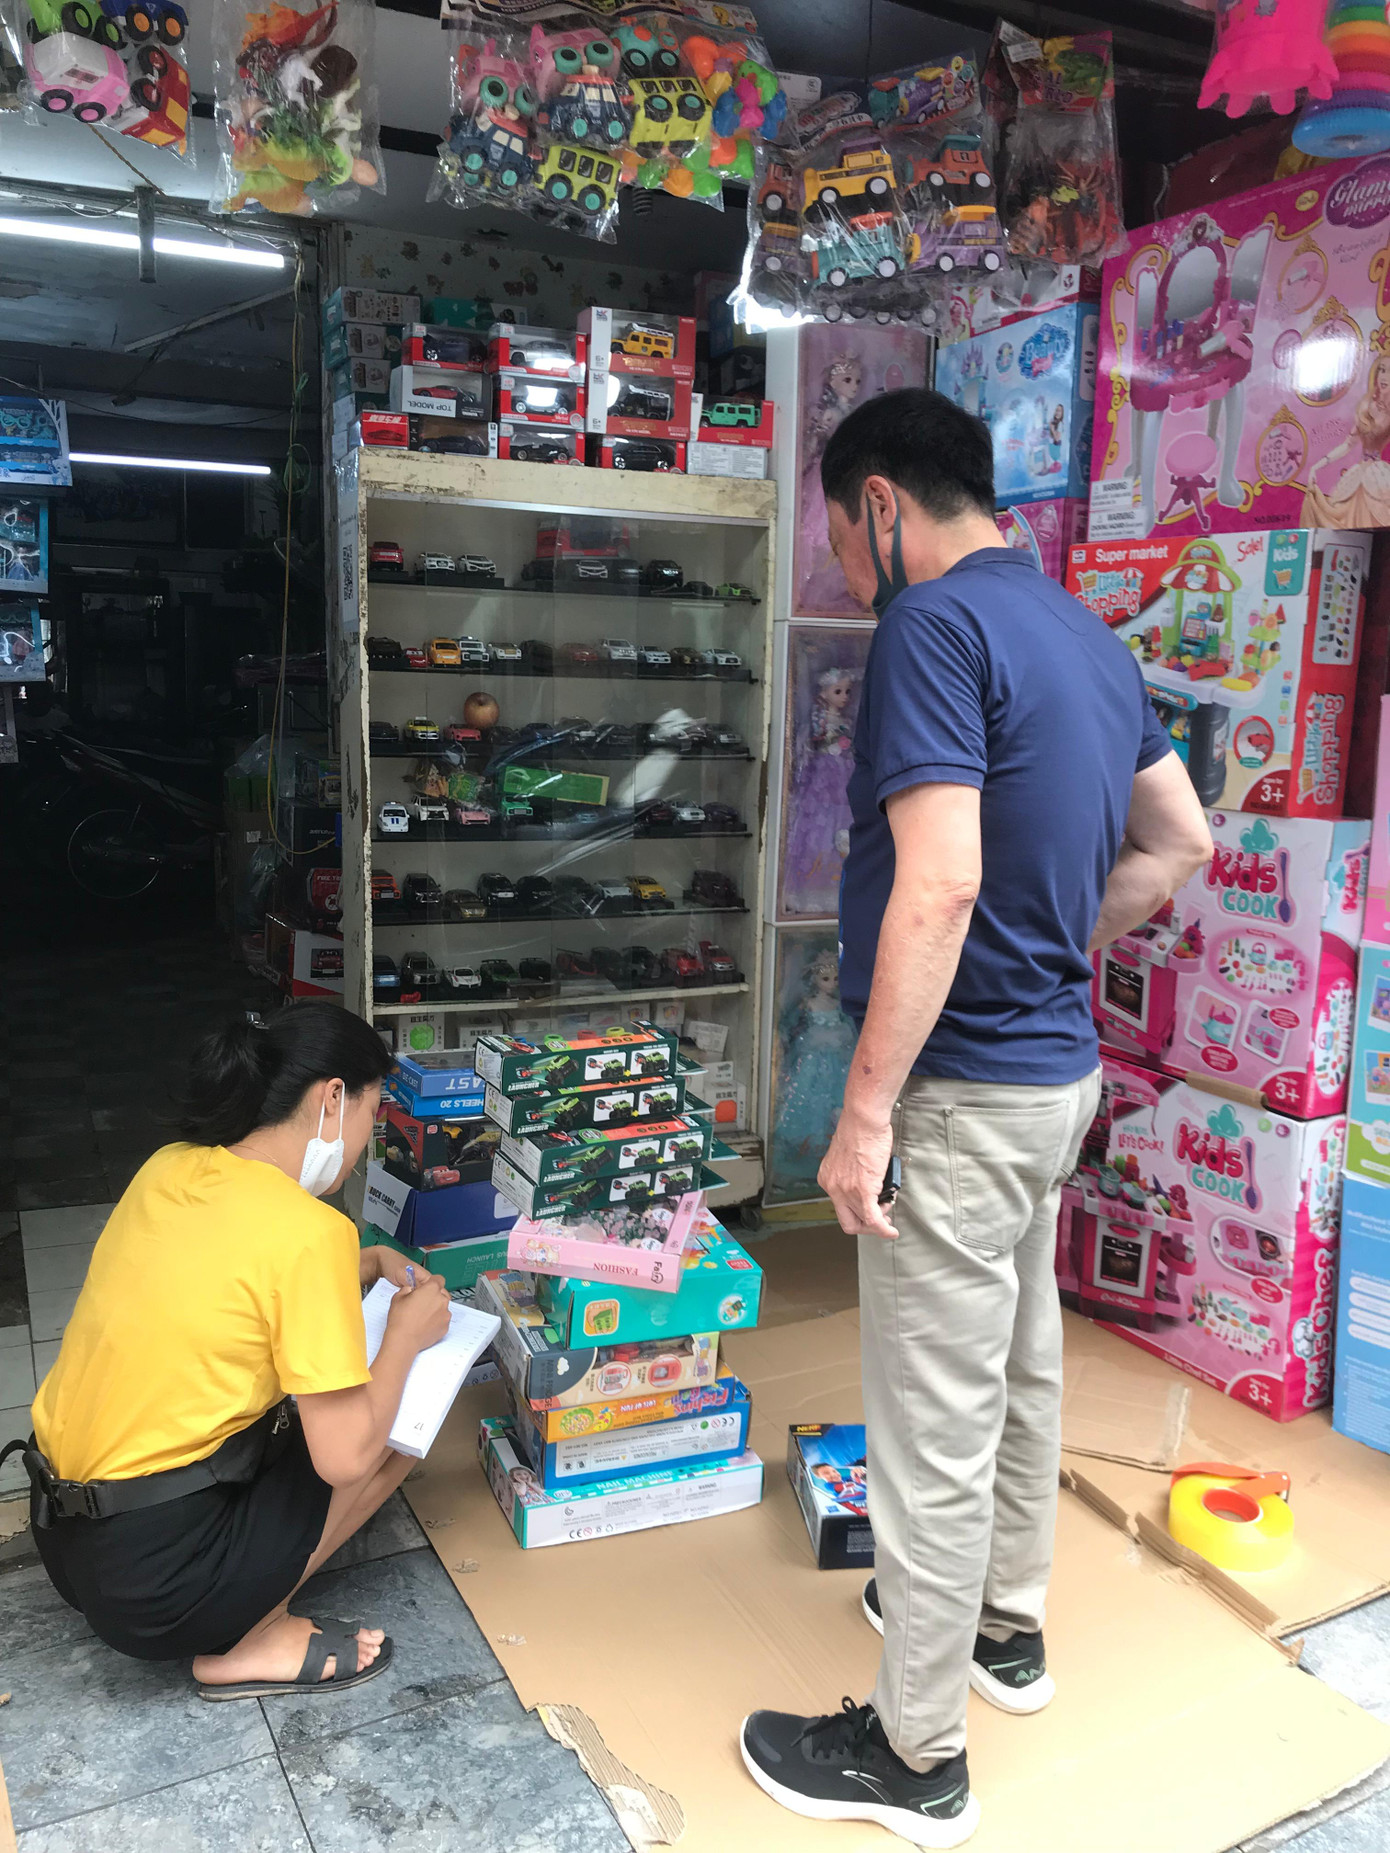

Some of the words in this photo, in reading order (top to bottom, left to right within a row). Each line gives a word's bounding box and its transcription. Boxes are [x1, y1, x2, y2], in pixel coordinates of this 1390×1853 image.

[1330, 178, 1390, 208] Glam
[407, 400, 434, 411] MODEL
[436, 404, 452, 412] TOP
[1095, 548, 1127, 564] Super
[1129, 545, 1168, 560] market
[1273, 548, 1299, 562] Kids
[1313, 696, 1343, 803] Shopping
[1260, 784, 1284, 803] 3+
[1207, 848, 1278, 894] Kids
[1342, 859, 1361, 912] Kids
[1222, 890, 1279, 919] COOK
[445, 1077, 486, 1090] AST
[1275, 1080, 1300, 1103] 3+
[440, 1100, 452, 1109] 20
[1177, 1122, 1244, 1178] Kids
[1191, 1165, 1246, 1205] COOK
[381, 1193, 396, 1209] CARRY
[466, 1254, 494, 1263] LAUNCH
[593, 1262, 639, 1277] FASHION
[651, 1261, 664, 1283] Fairy
[674, 1387, 729, 1414] Fishing
[1249, 1384, 1273, 1406] 3+
[597, 1479, 623, 1490] NAIL
[625, 1470, 673, 1487] MACHINE
